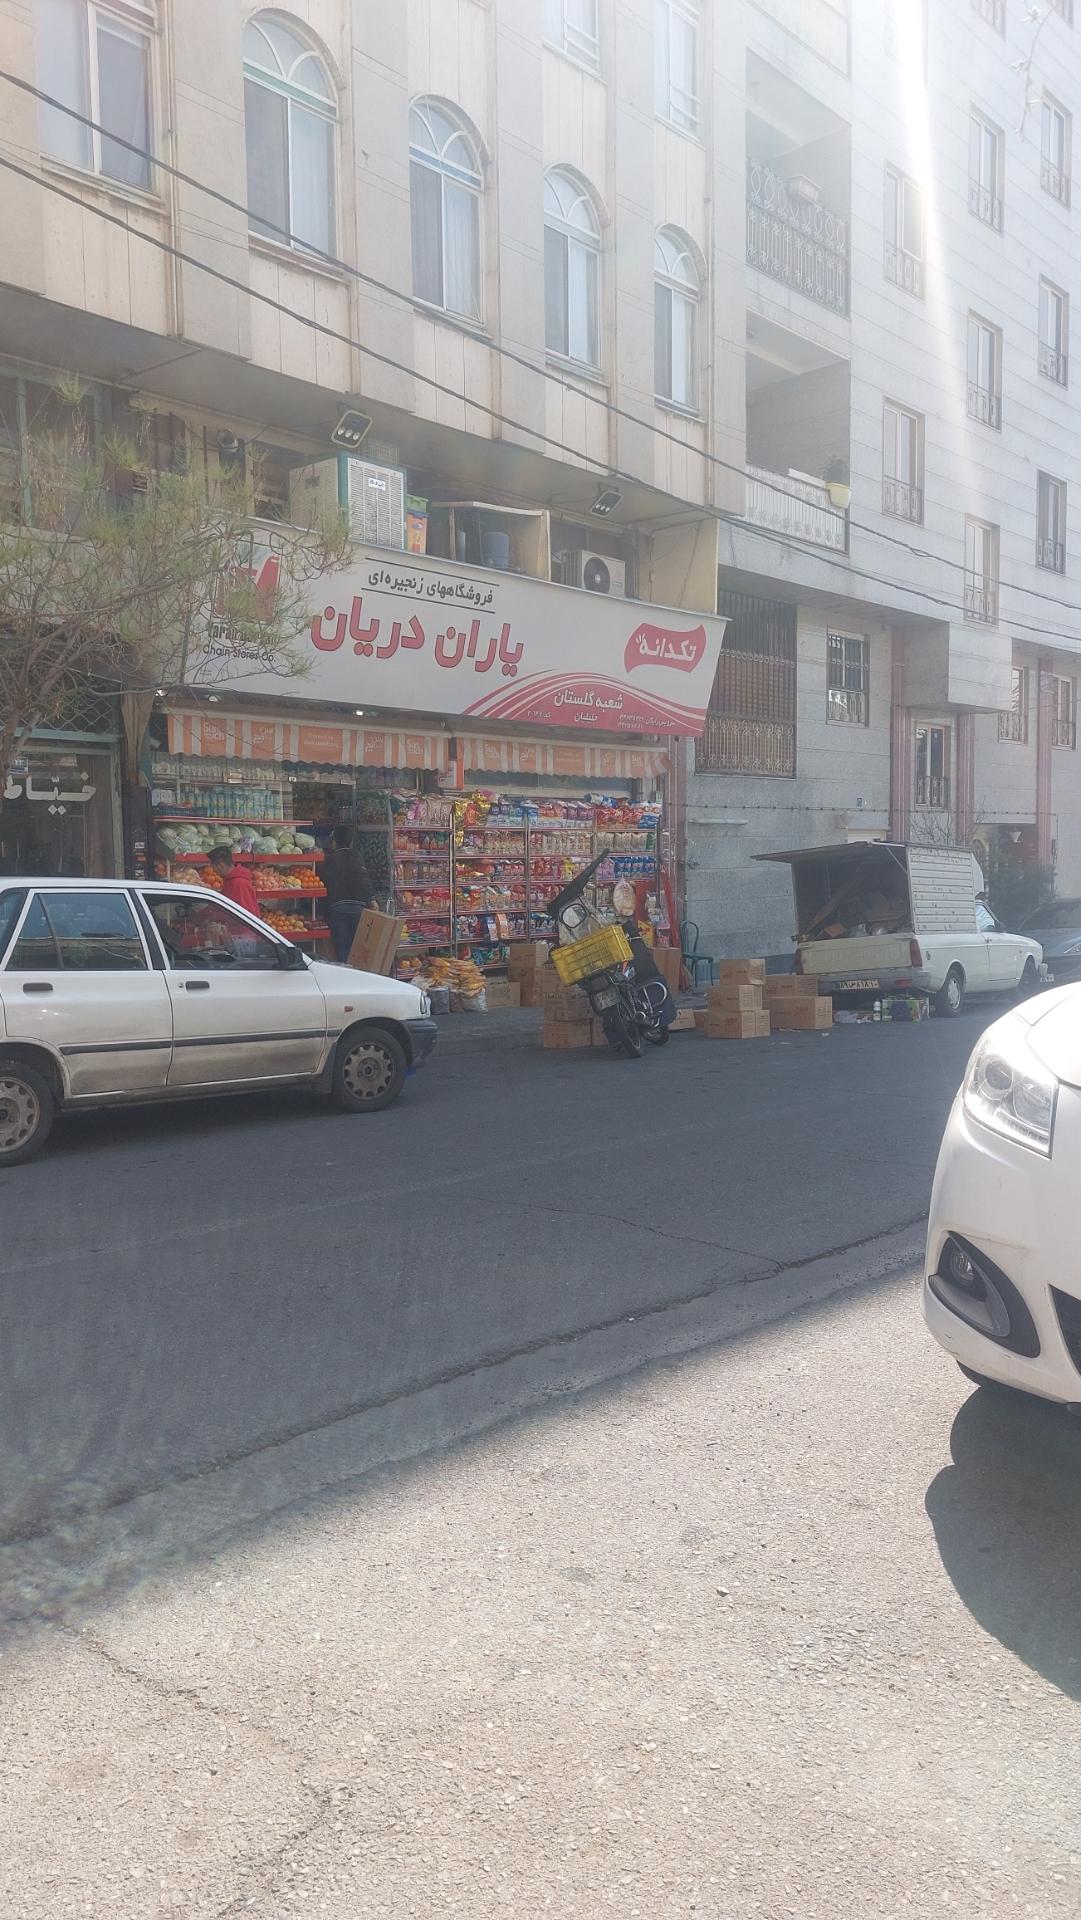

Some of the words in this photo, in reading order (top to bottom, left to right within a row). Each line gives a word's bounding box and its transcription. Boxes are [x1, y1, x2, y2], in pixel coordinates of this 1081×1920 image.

[427, 579, 493, 606] فروشگاههای
[311, 596, 425, 660] دریان
[203, 644, 230, 657] Chain
[233, 648, 260, 661] Stores
[434, 620, 524, 677] یاران
[635, 633, 697, 662] تکدانه
[553, 689, 595, 707] گلستان
[596, 693, 624, 713] شعبه
